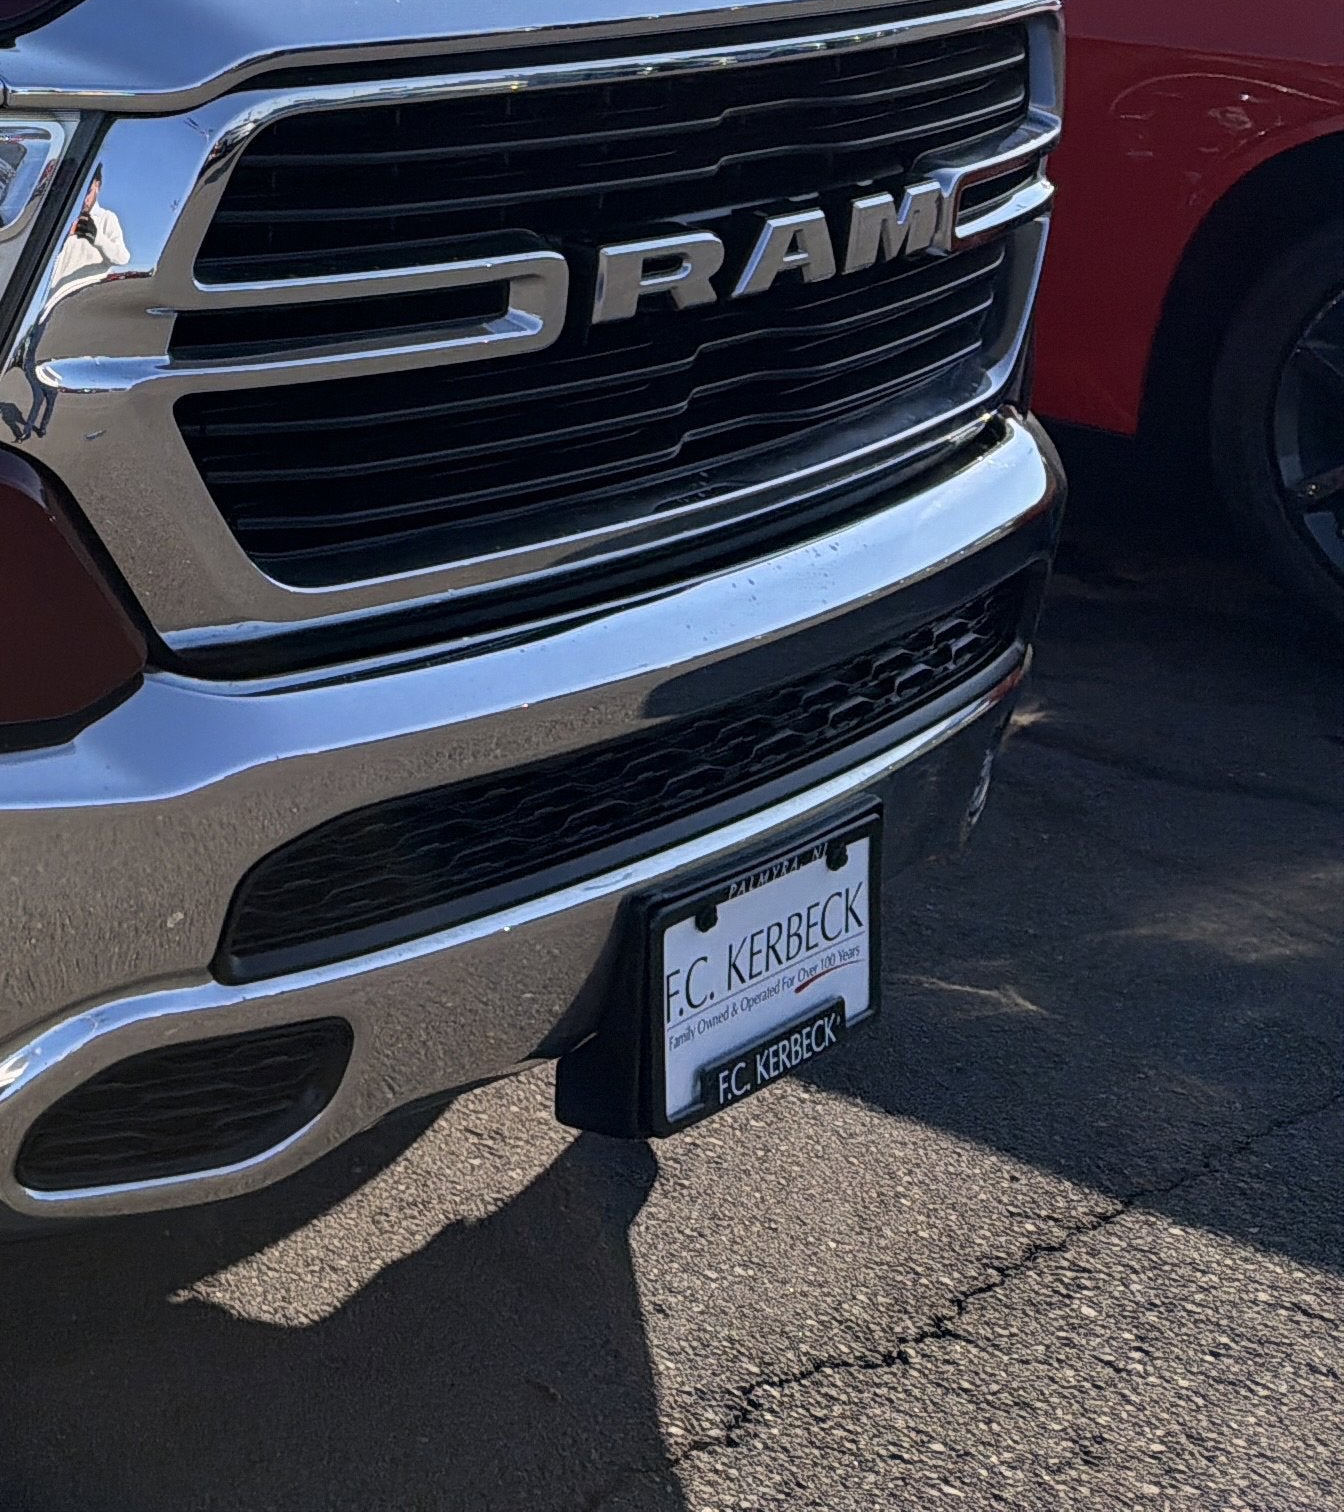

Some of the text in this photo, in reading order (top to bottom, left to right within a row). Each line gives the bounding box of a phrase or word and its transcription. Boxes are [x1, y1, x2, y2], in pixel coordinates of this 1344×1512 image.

[590, 180, 948, 325] RAM
[666, 881, 864, 1024] F.C. KERBECK
[668, 944, 861, 1052] Family Owned & Operated For Over 100 Years
[718, 1013, 838, 1105] F.C. KERBECK
